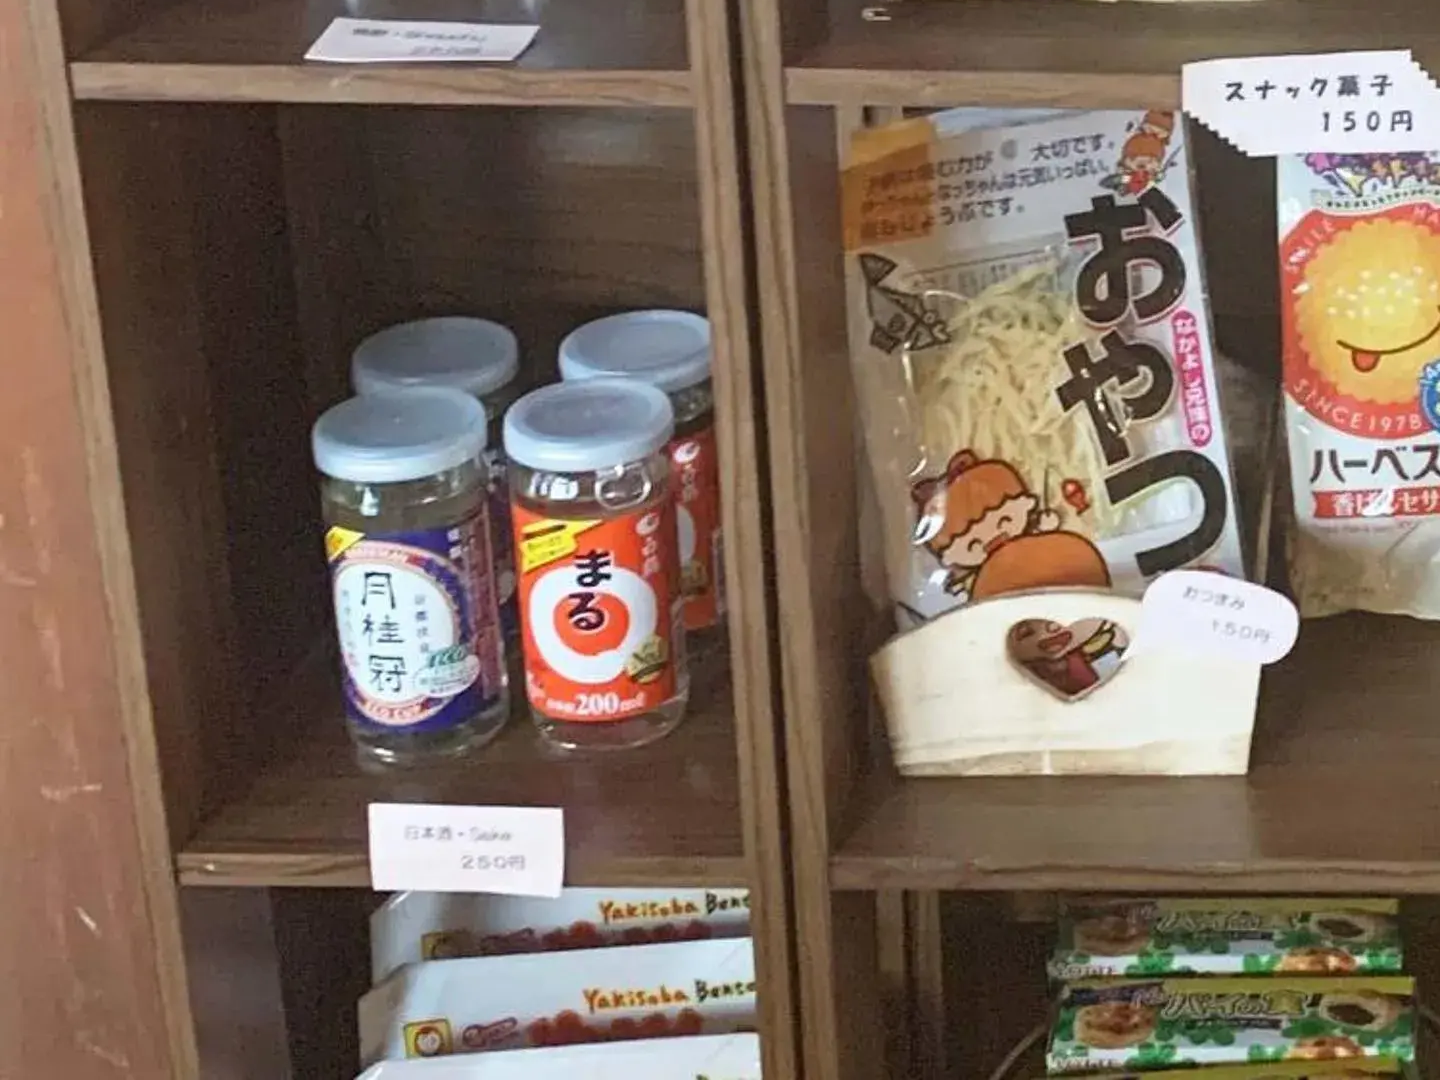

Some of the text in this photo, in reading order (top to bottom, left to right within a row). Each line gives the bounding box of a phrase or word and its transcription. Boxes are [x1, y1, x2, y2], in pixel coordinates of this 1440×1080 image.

[1224, 75, 1394, 102] スナック菓子
[1322, 109, 1414, 133] 150円
[1055, 186, 1228, 578] おやつ
[1292, 376, 1421, 431] SINCE 1978
[568, 549, 612, 631] まる
[361, 571, 408, 693] 月桂冠
[599, 896, 698, 925] Yakisoba
[584, 984, 690, 1015] Yakisoba
